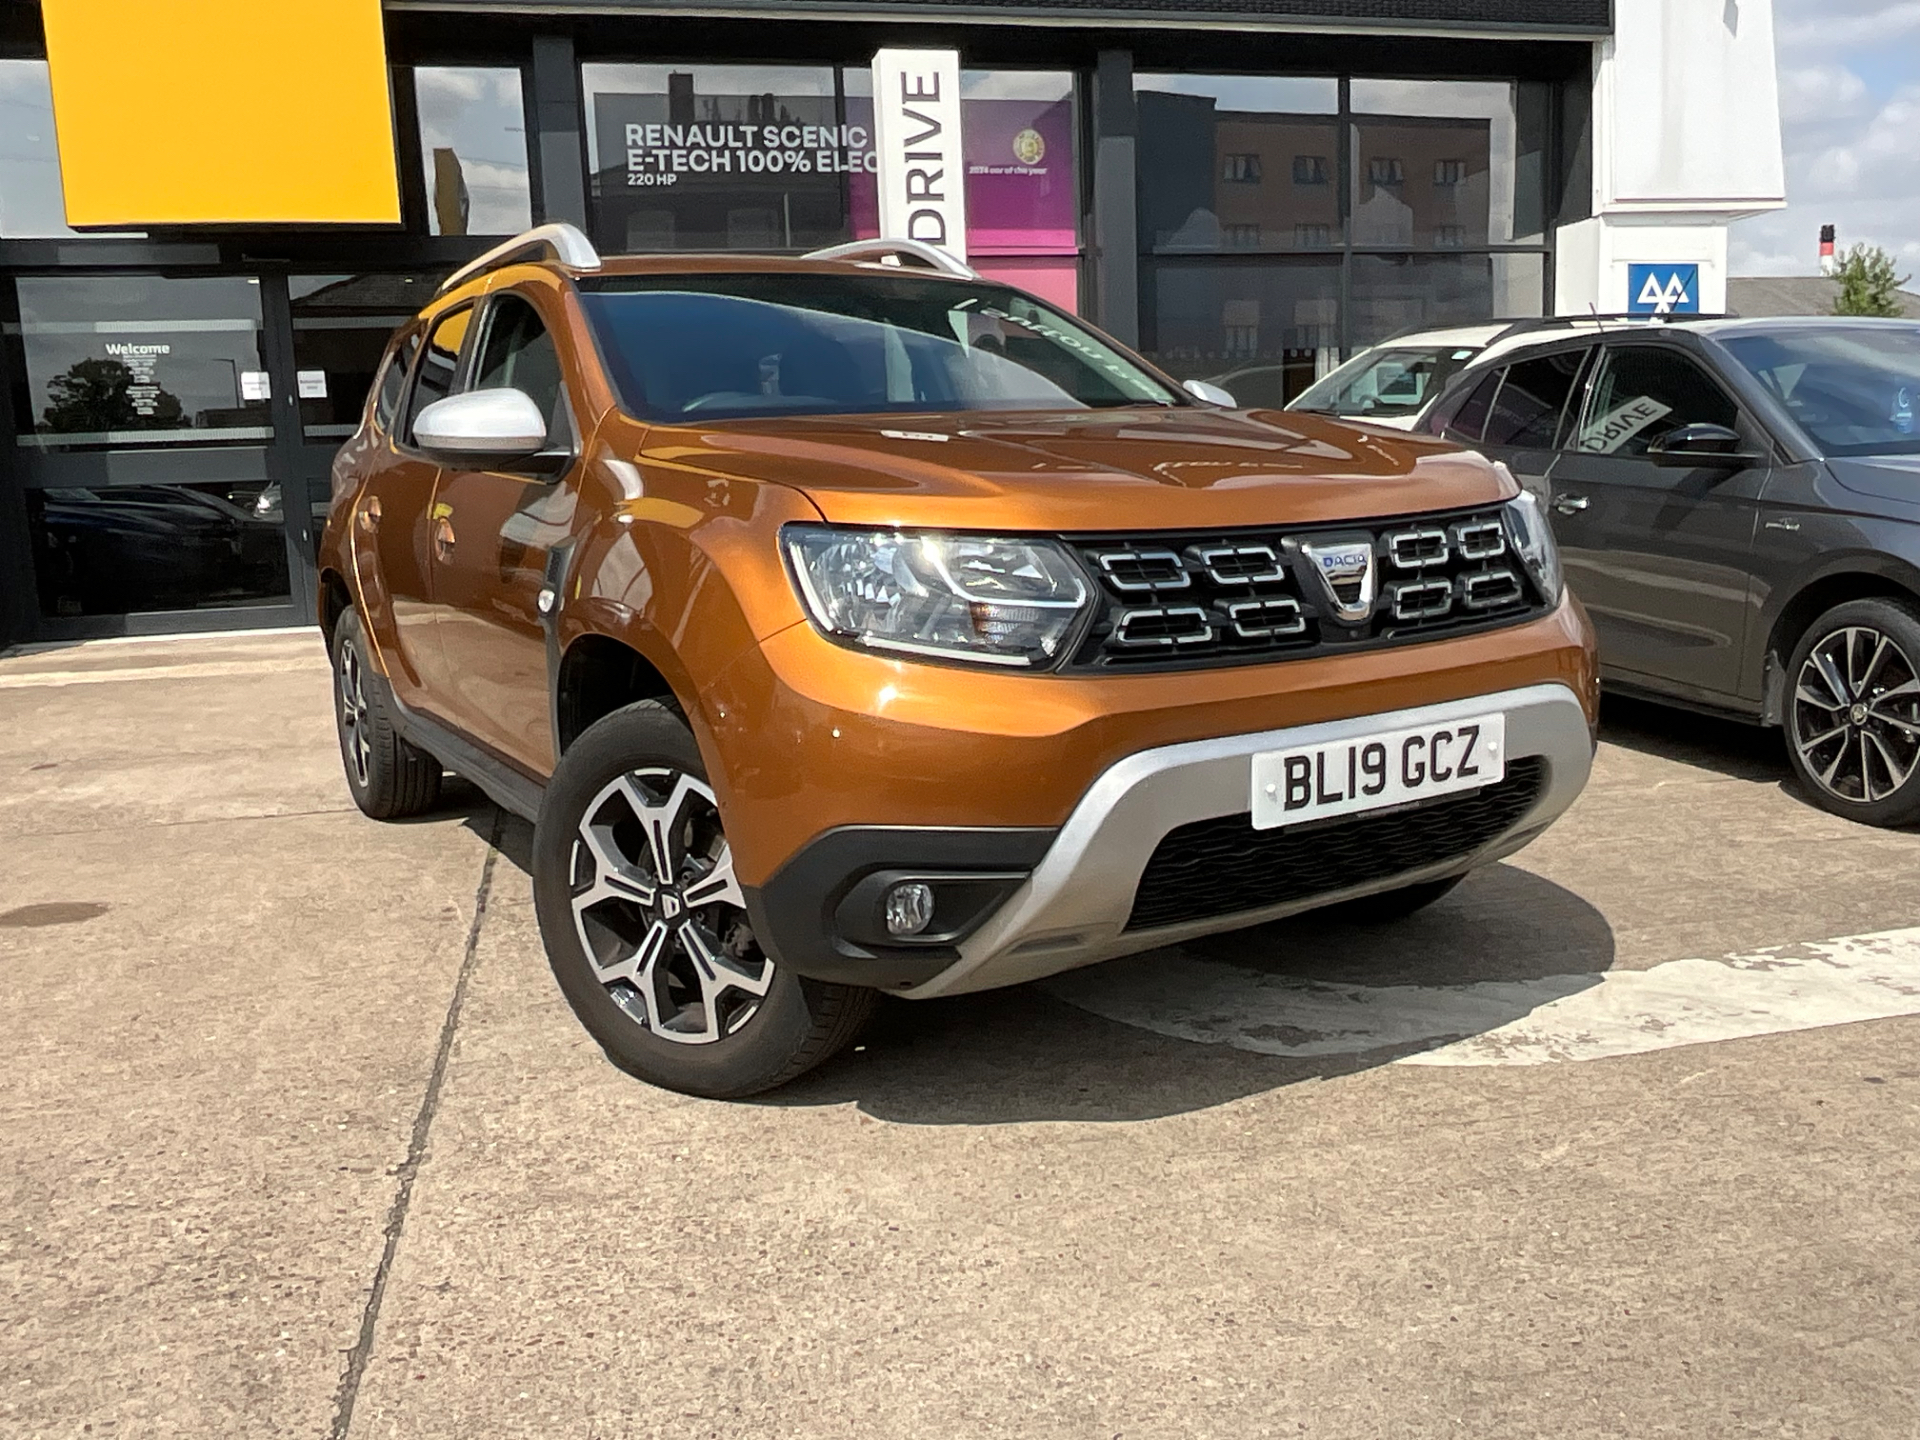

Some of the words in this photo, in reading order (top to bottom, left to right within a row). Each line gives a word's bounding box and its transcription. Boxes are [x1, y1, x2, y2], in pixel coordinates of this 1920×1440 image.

[625, 123, 758, 148] RENAULT
[763, 124, 868, 148] SCENIC
[627, 149, 731, 172] E-TECH
[736, 150, 812, 173] 100%
[901, 71, 946, 246] DRIVE
[627, 173, 654, 186] 220
[656, 173, 677, 186] HP
[105, 342, 170, 355] Welcome
[1323, 553, 1367, 568] DACIA
[1283, 741, 1387, 812] BL19
[1402, 724, 1480, 789] GCZ
